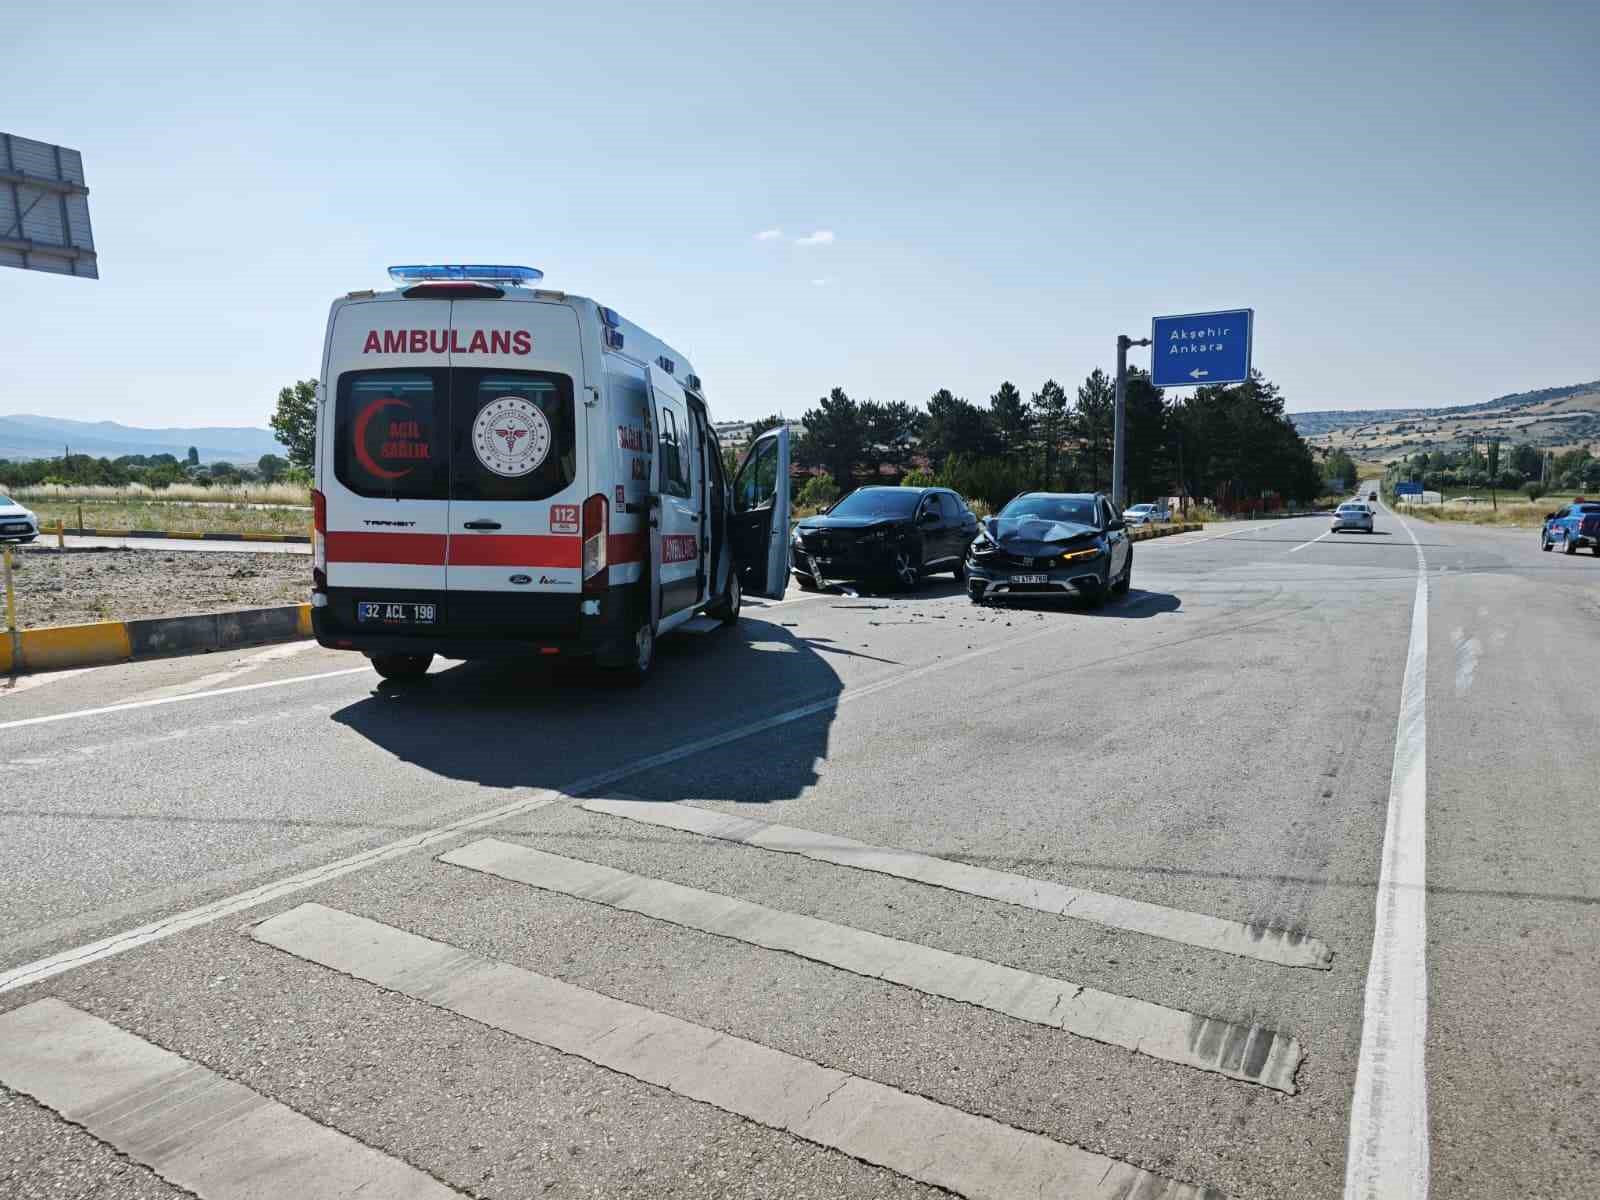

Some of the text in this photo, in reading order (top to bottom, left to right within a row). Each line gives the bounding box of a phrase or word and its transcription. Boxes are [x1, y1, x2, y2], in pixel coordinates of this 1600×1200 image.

[1170, 328, 1231, 340] Akşehir
[363, 329, 532, 355] AMBULANS
[1169, 343, 1224, 354] Ankara
[555, 508, 576, 522] 112
[366, 604, 380, 618] 32
[385, 605, 407, 619] ACL
